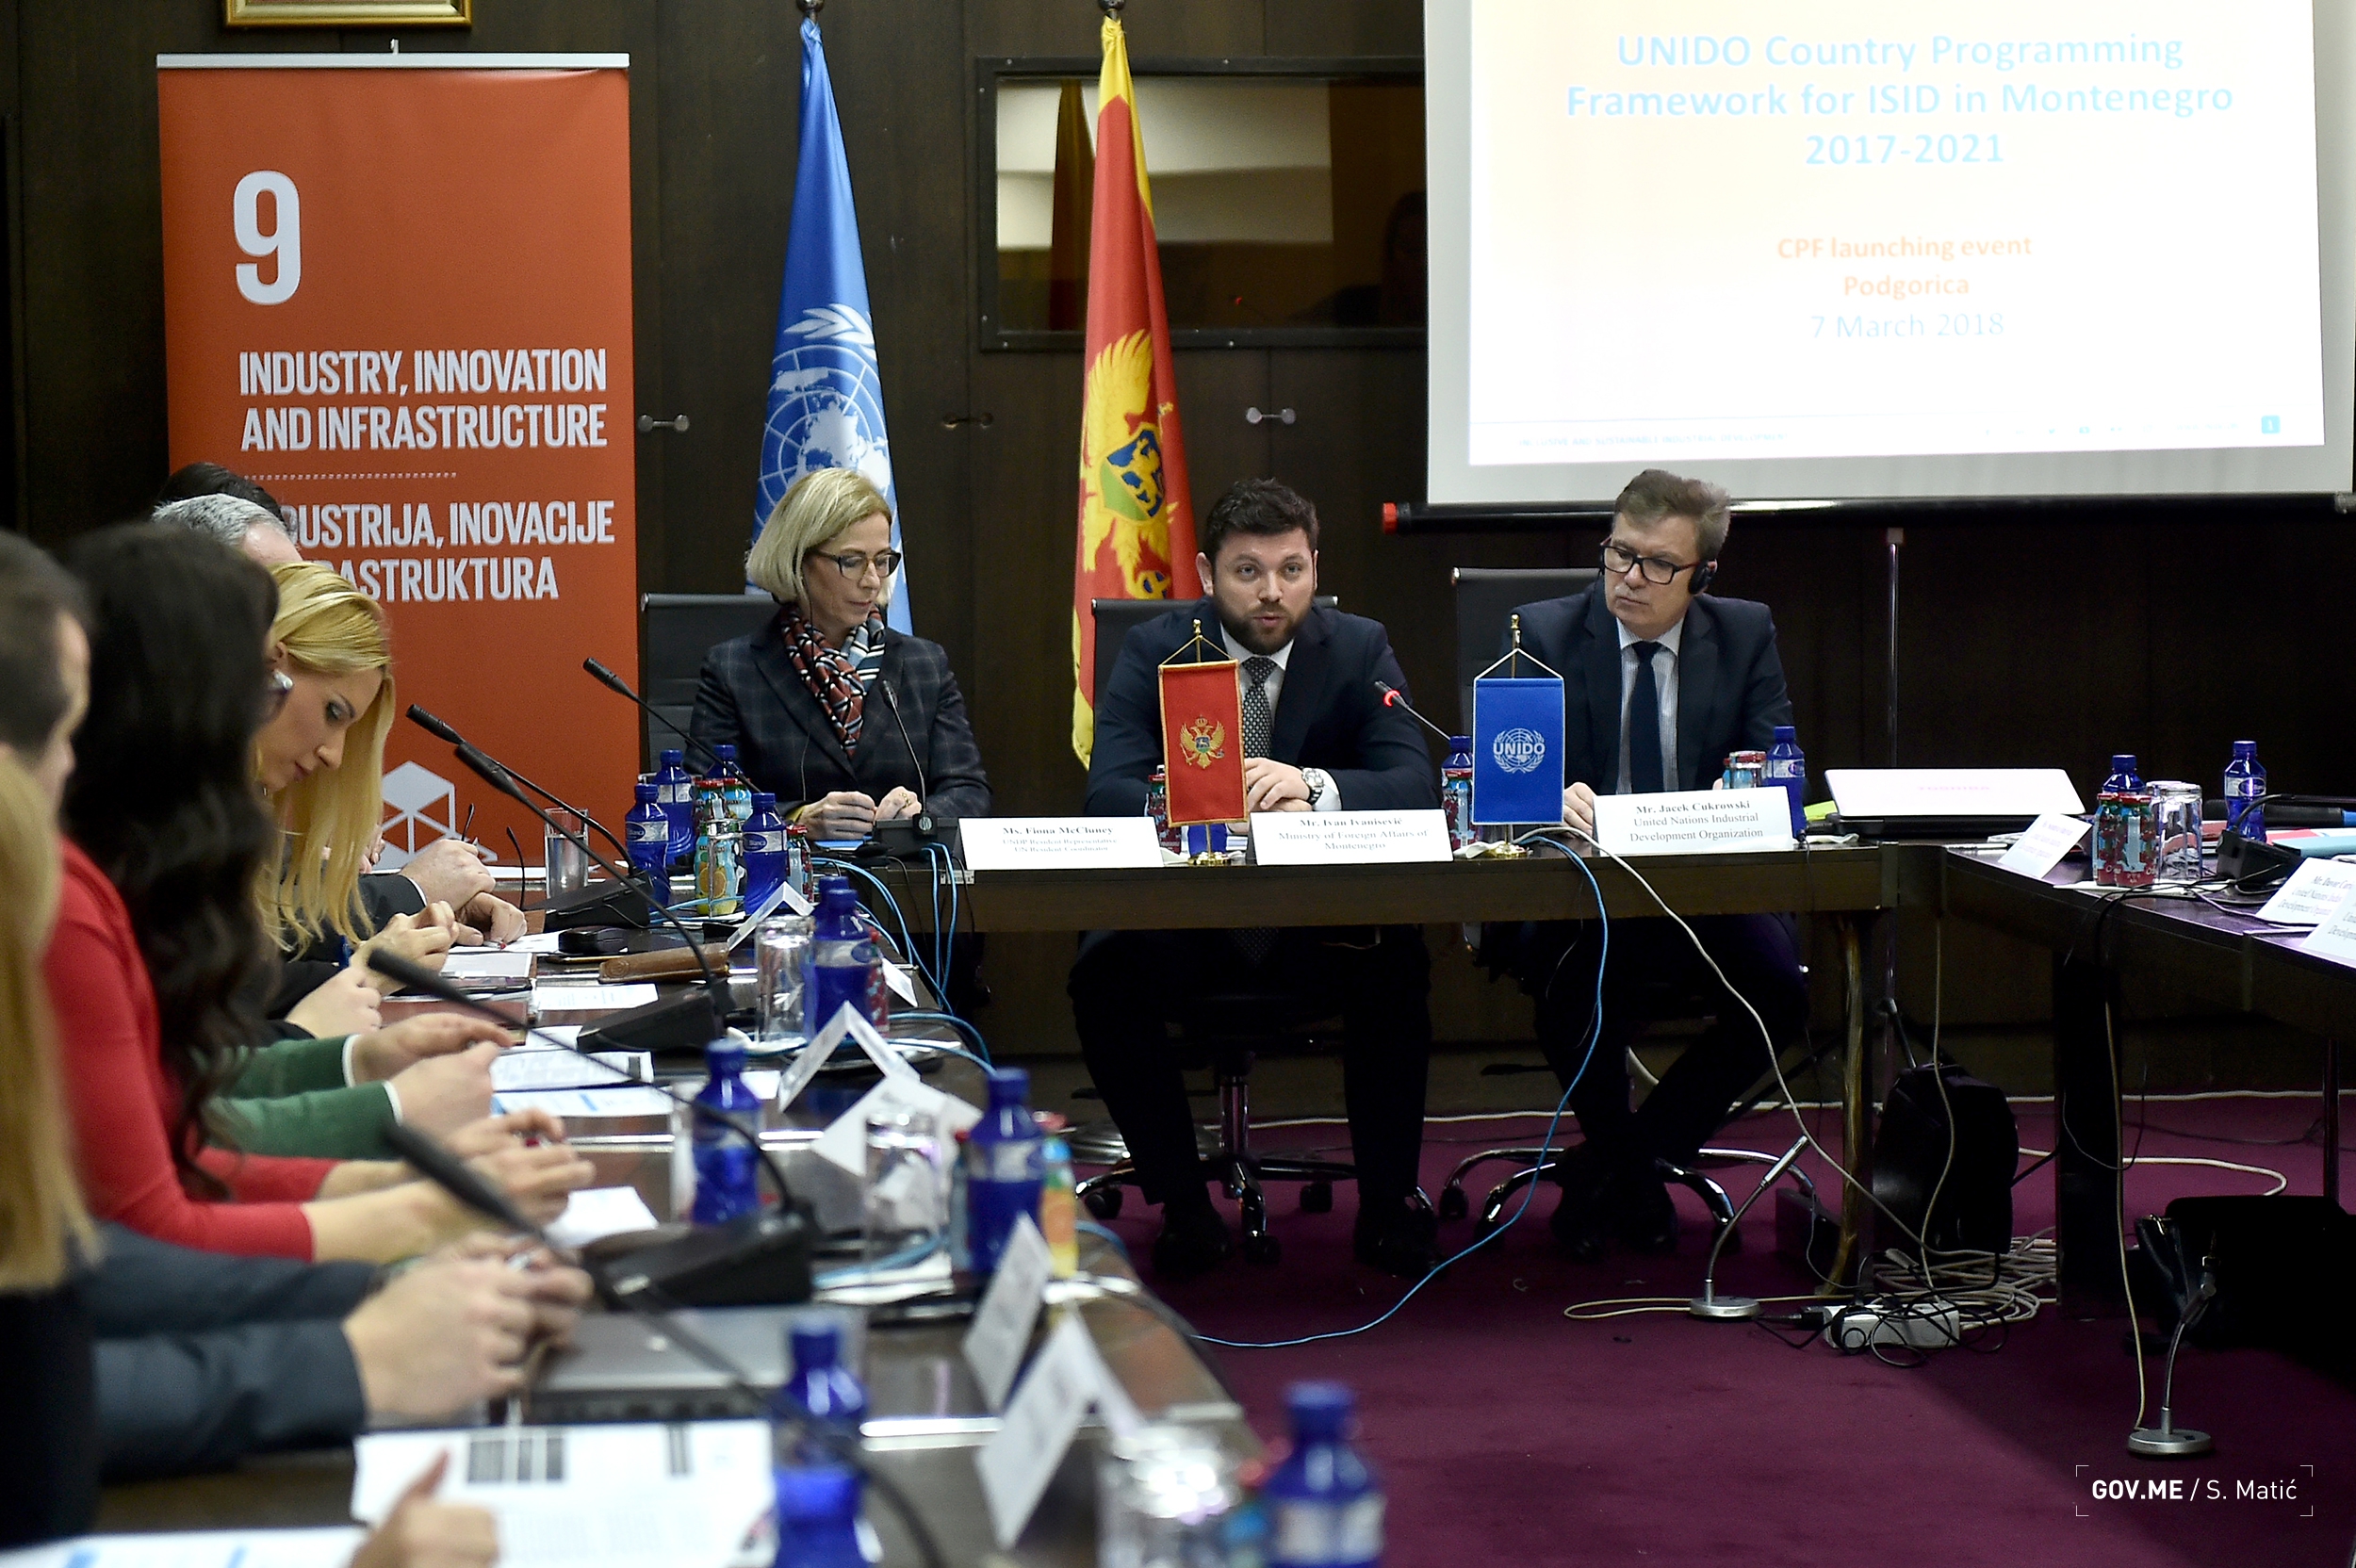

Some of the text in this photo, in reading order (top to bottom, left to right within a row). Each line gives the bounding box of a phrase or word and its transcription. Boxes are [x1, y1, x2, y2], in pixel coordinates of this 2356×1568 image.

[1618, 34, 2184, 72] UNIDO Country Programming
[1568, 83, 2233, 118] Framework for ISID in Montenegro
[1806, 134, 2004, 165] 2017-2021
[233, 170, 302, 305] 9
[1777, 236, 2032, 262] CPF launching event
[1844, 274, 1970, 301] Podgorica
[1810, 312, 2004, 338] 7 March 2018
[239, 348, 607, 397] INDUSTRY, INNOVATION
[240, 403, 608, 452] AND INFRASTRUCTURE
[281, 499, 615, 549] DUSTRIJA, INOVACIJE
[1493, 742, 1546, 755] UNIDO
[1633, 813, 1759, 826] United Nations Industrial
[1636, 801, 1751, 814] Mr. Jacek Cukrowski
[1025, 826, 1055, 835] Fiona
[1058, 826, 1114, 836] McCluney
[1279, 832, 1321, 841] Ministry
[1337, 831, 1377, 841] Foreign
[1380, 829, 1415, 839] Affairs
[1417, 829, 1429, 838] of
[1300, 819, 1320, 827] Mr.
[1629, 828, 1764, 842] Development Organization
[1324, 841, 1386, 851] Montenegro
